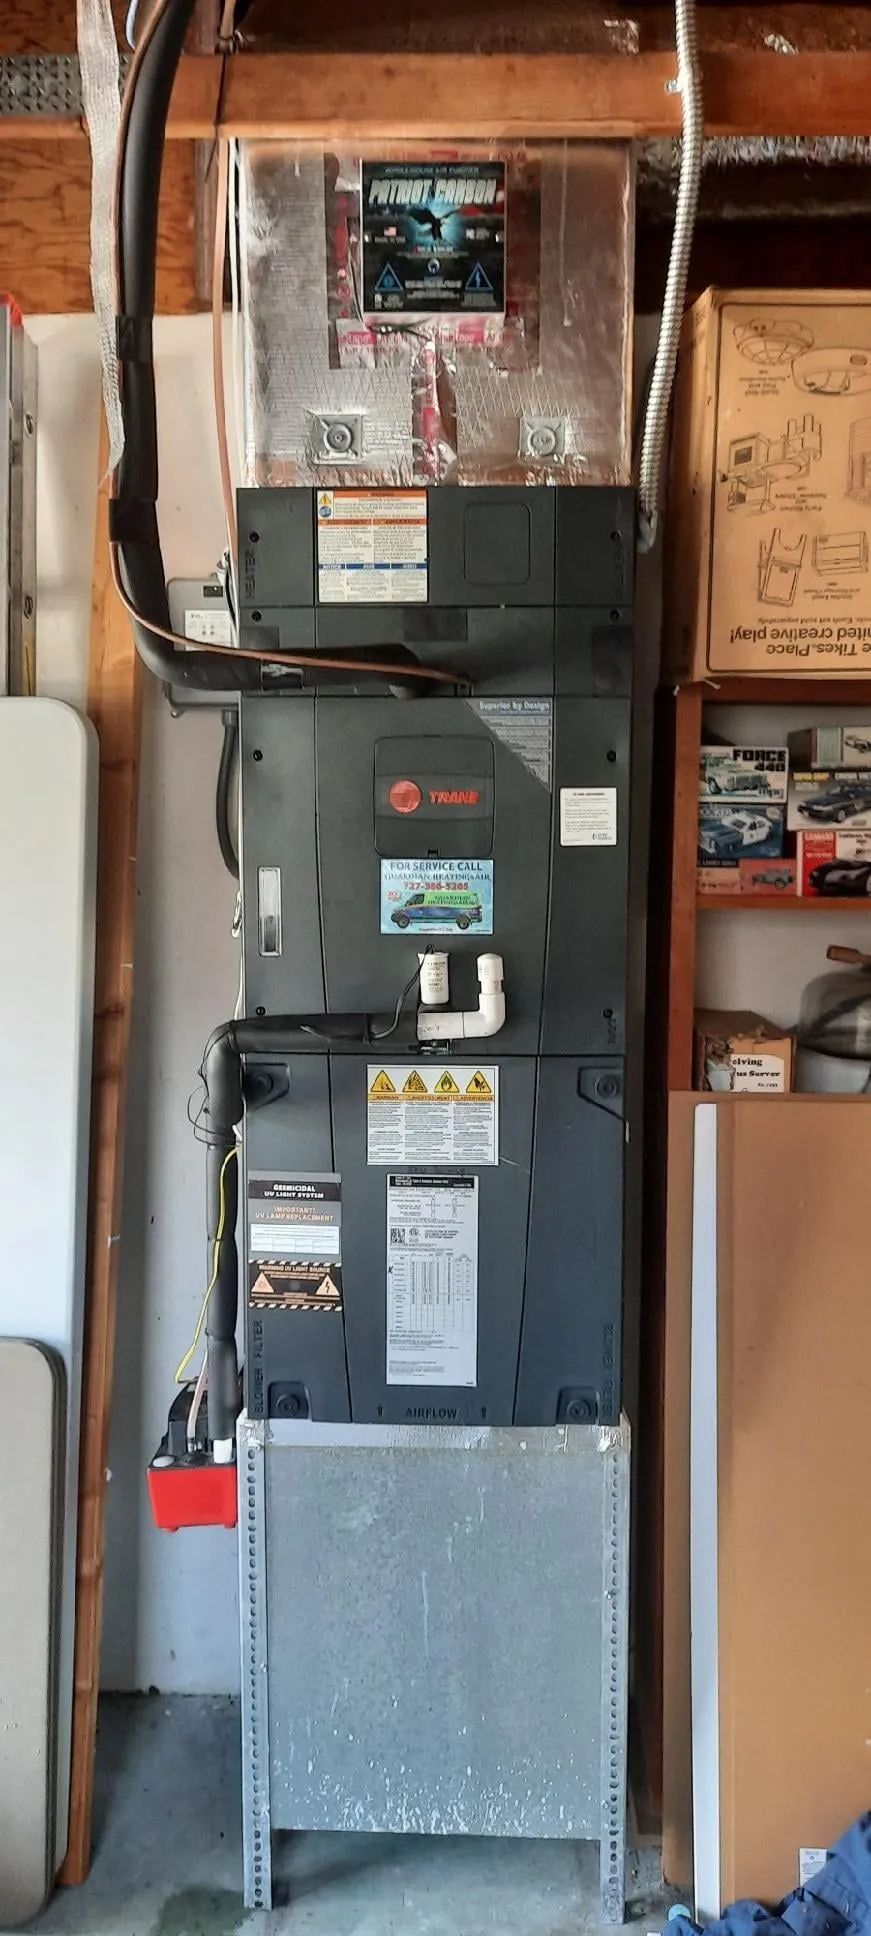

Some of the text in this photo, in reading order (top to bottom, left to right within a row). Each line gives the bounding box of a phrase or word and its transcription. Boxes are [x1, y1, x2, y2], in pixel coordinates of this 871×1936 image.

[368, 179, 434, 205] PATRIOT
[730, 626, 767, 644] play!
[770, 628, 833, 644] creative
[765, 644, 810, 657] Place
[512, 700, 522, 711] by
[524, 700, 550, 711] Design
[733, 750, 786, 761] FORCE
[429, 790, 480, 804] TRANE
[390, 862, 482, 872] FOR SERVICE CALL
[273, 1184, 316, 1192] GERMICIDAL
[274, 1206, 316, 1214] IMPORTANT!
[285, 1214, 334, 1222] REPLACEMENT
[254, 1320, 264, 1359] FILTER
[406, 1408, 458, 1420] AIRFLOW
